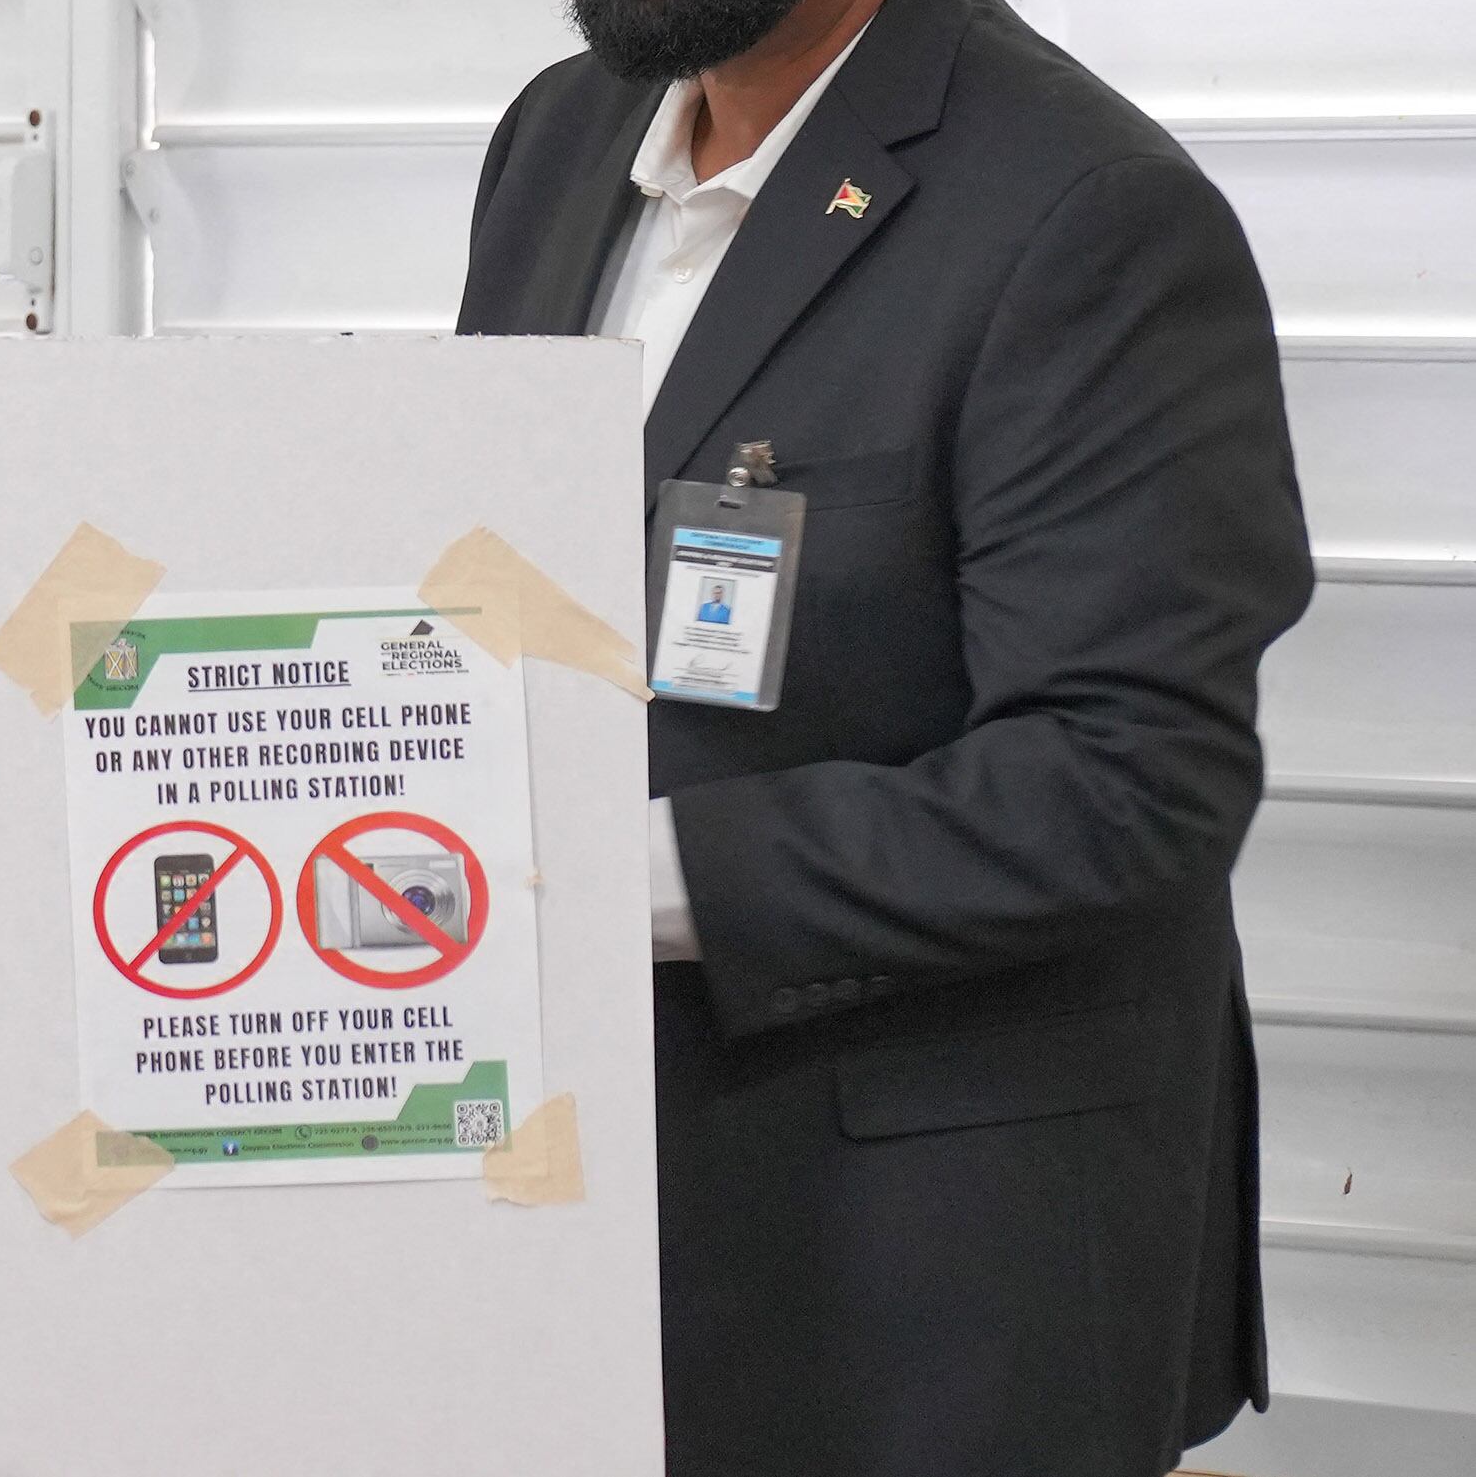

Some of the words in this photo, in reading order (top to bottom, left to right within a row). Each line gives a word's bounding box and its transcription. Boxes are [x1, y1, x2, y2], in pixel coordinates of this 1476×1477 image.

[380, 640, 445, 651] GENERAL
[391, 650, 462, 660] REGIONAL
[187, 663, 262, 688] STRICT
[272, 660, 350, 684] NOTICE
[382, 659, 463, 671] ELECTIONS
[85, 715, 125, 739] YOU
[135, 712, 218, 737] CANNOT
[227, 710, 267, 733] USE
[276, 708, 331, 731] YOUR
[341, 705, 392, 729] CELL
[401, 703, 472, 727] PHONE
[95, 751, 123, 773] OR
[132, 748, 172, 772] ANY
[182, 745, 249, 769] OTHER
[259, 741, 380, 765] RECORDING
[389, 737, 465, 762] DEVICE
[157, 782, 178, 805] IN
[188, 782, 201, 804] A
[210, 778, 298, 802] POLLING
[308, 774, 404, 799] STATION!
[143, 1014, 220, 1039] PLEASE
[229, 1012, 282, 1036] TURN
[292, 1010, 329, 1033] OFF
[338, 1008, 393, 1031] YOUR
[403, 1005, 453, 1029] CELL
[136, 1049, 205, 1074] PHONE
[214, 1046, 292, 1070] BEFORE
[300, 1043, 341, 1067] YOU
[351, 1041, 416, 1065] ENTER
[424, 1039, 464, 1062] THE
[205, 1080, 292, 1105] POLLING
[301, 1076, 396, 1101] STATION!
